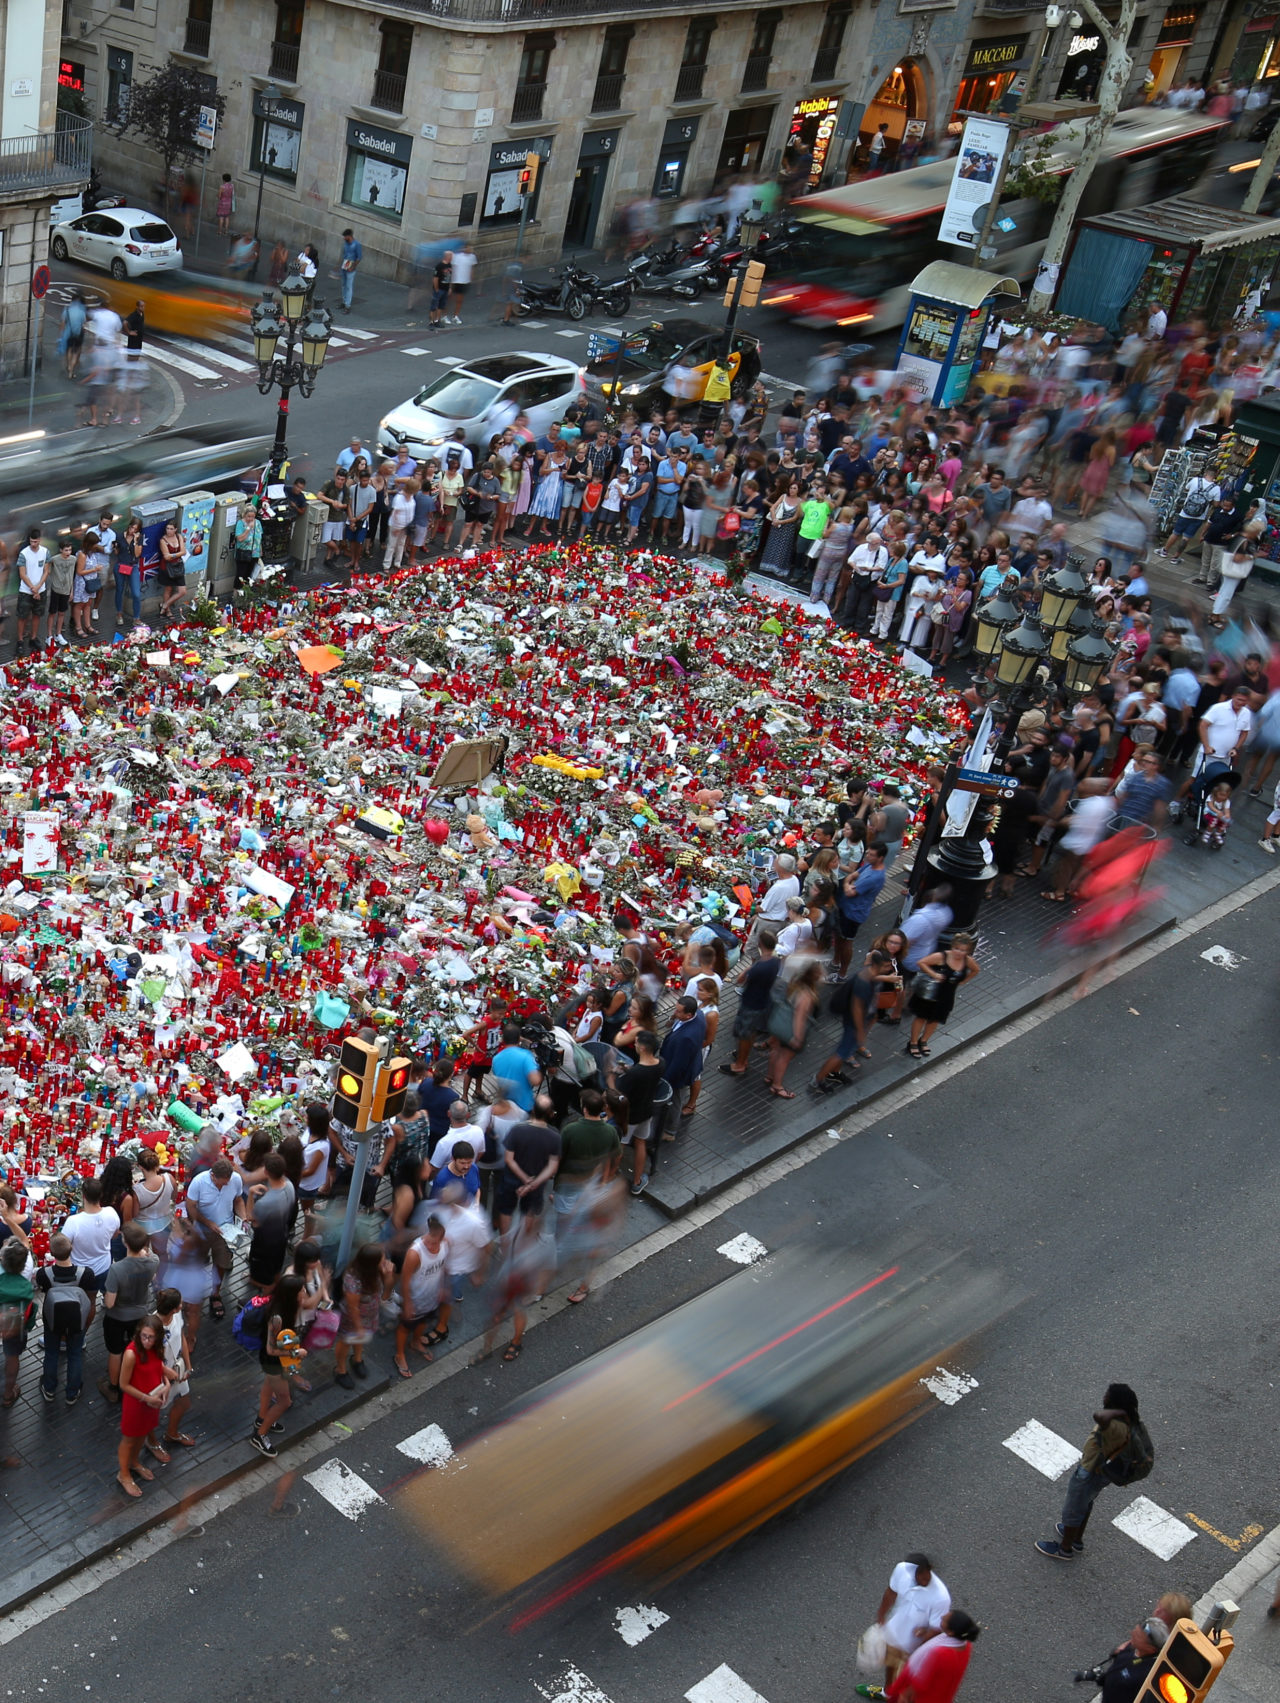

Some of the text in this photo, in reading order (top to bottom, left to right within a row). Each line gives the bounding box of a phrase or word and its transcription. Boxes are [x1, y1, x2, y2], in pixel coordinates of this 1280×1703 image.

[972, 45, 1018, 64] MACCABI
[798, 97, 831, 114] Habibi
[358, 132, 396, 155] Sabadell
